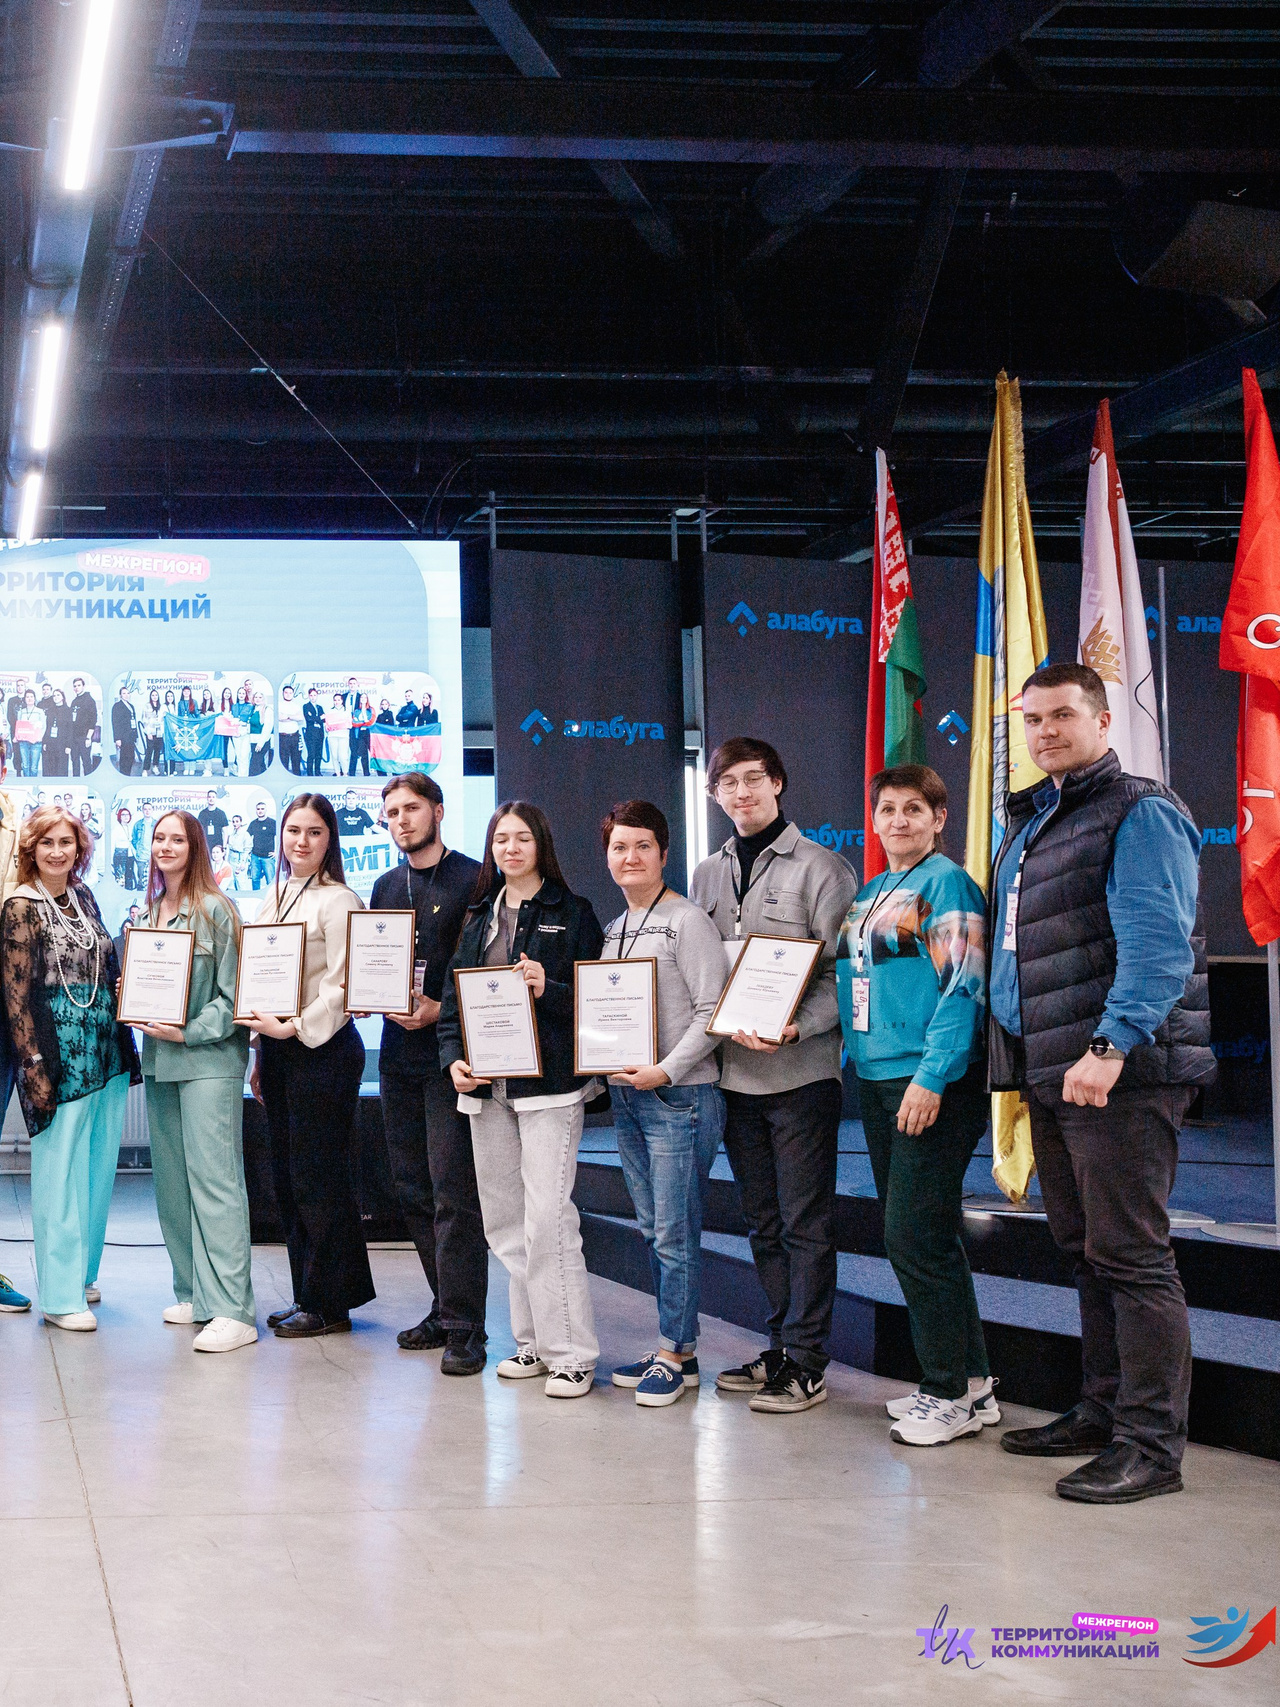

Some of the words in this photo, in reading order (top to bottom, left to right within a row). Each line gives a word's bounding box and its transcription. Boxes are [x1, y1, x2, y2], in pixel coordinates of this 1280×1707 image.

[85, 553, 203, 576] МЕЖРЕГИОН
[767, 609, 864, 640] алабуга
[563, 715, 666, 746] алабуга
